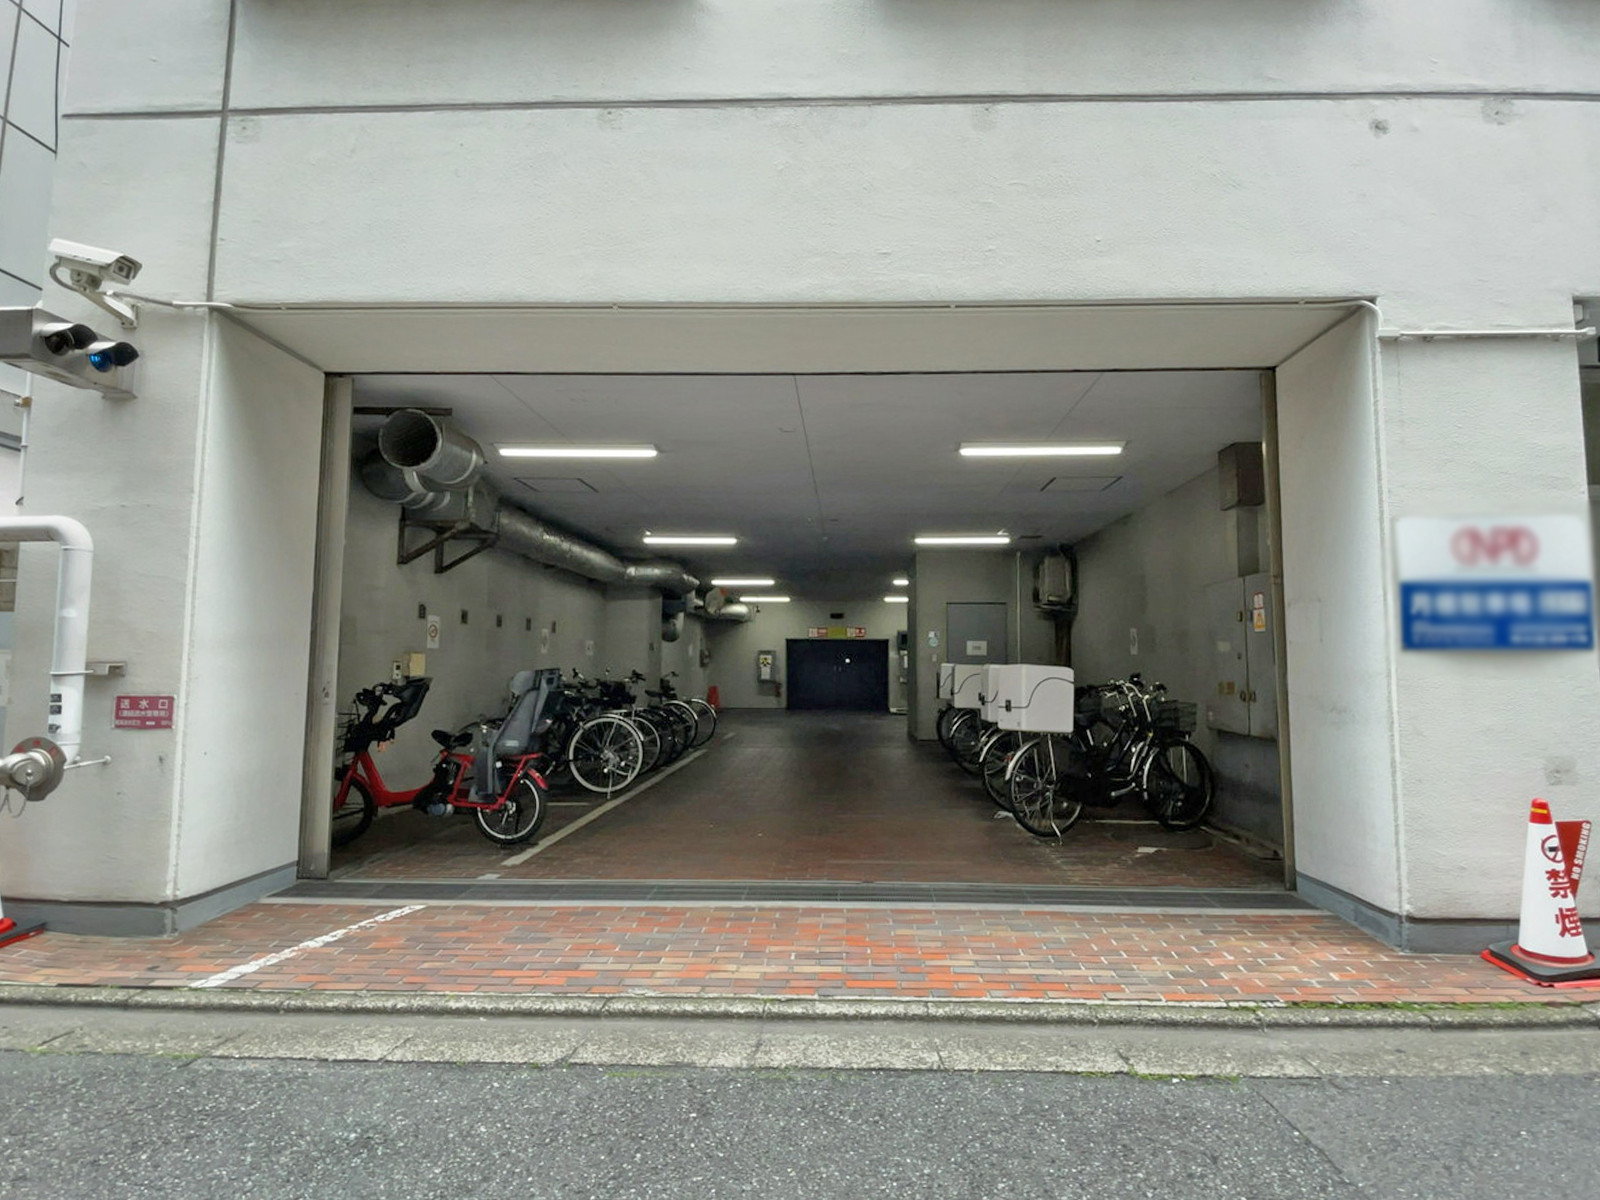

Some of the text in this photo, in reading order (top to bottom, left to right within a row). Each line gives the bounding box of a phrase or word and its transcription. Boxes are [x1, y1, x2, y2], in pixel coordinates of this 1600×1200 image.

[1570, 822, 1591, 881] NO SMOKING
[1545, 868, 1583, 938] 禁煙
